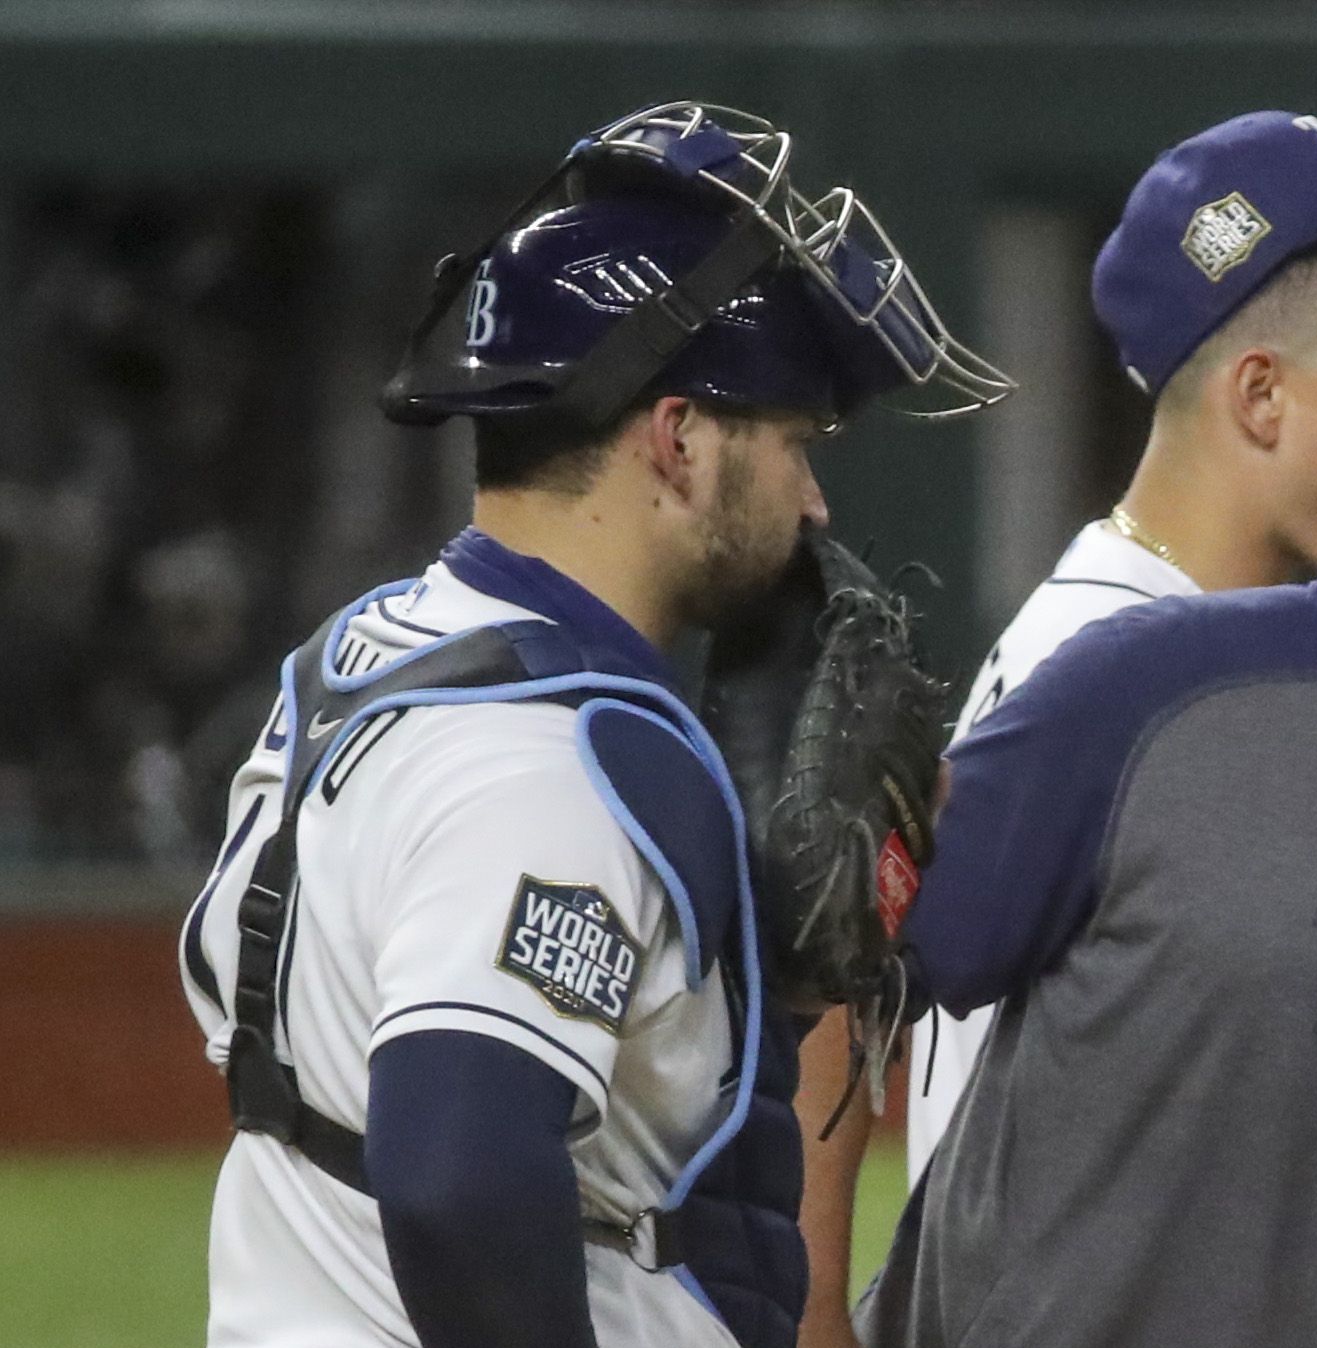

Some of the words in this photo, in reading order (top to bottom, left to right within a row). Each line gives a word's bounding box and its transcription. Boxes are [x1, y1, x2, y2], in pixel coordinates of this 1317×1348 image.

[1191, 201, 1250, 256] WORLD
[1201, 219, 1262, 274] SERIES
[509, 925, 629, 1019] SERIES
[524, 891, 637, 984] WORLD
